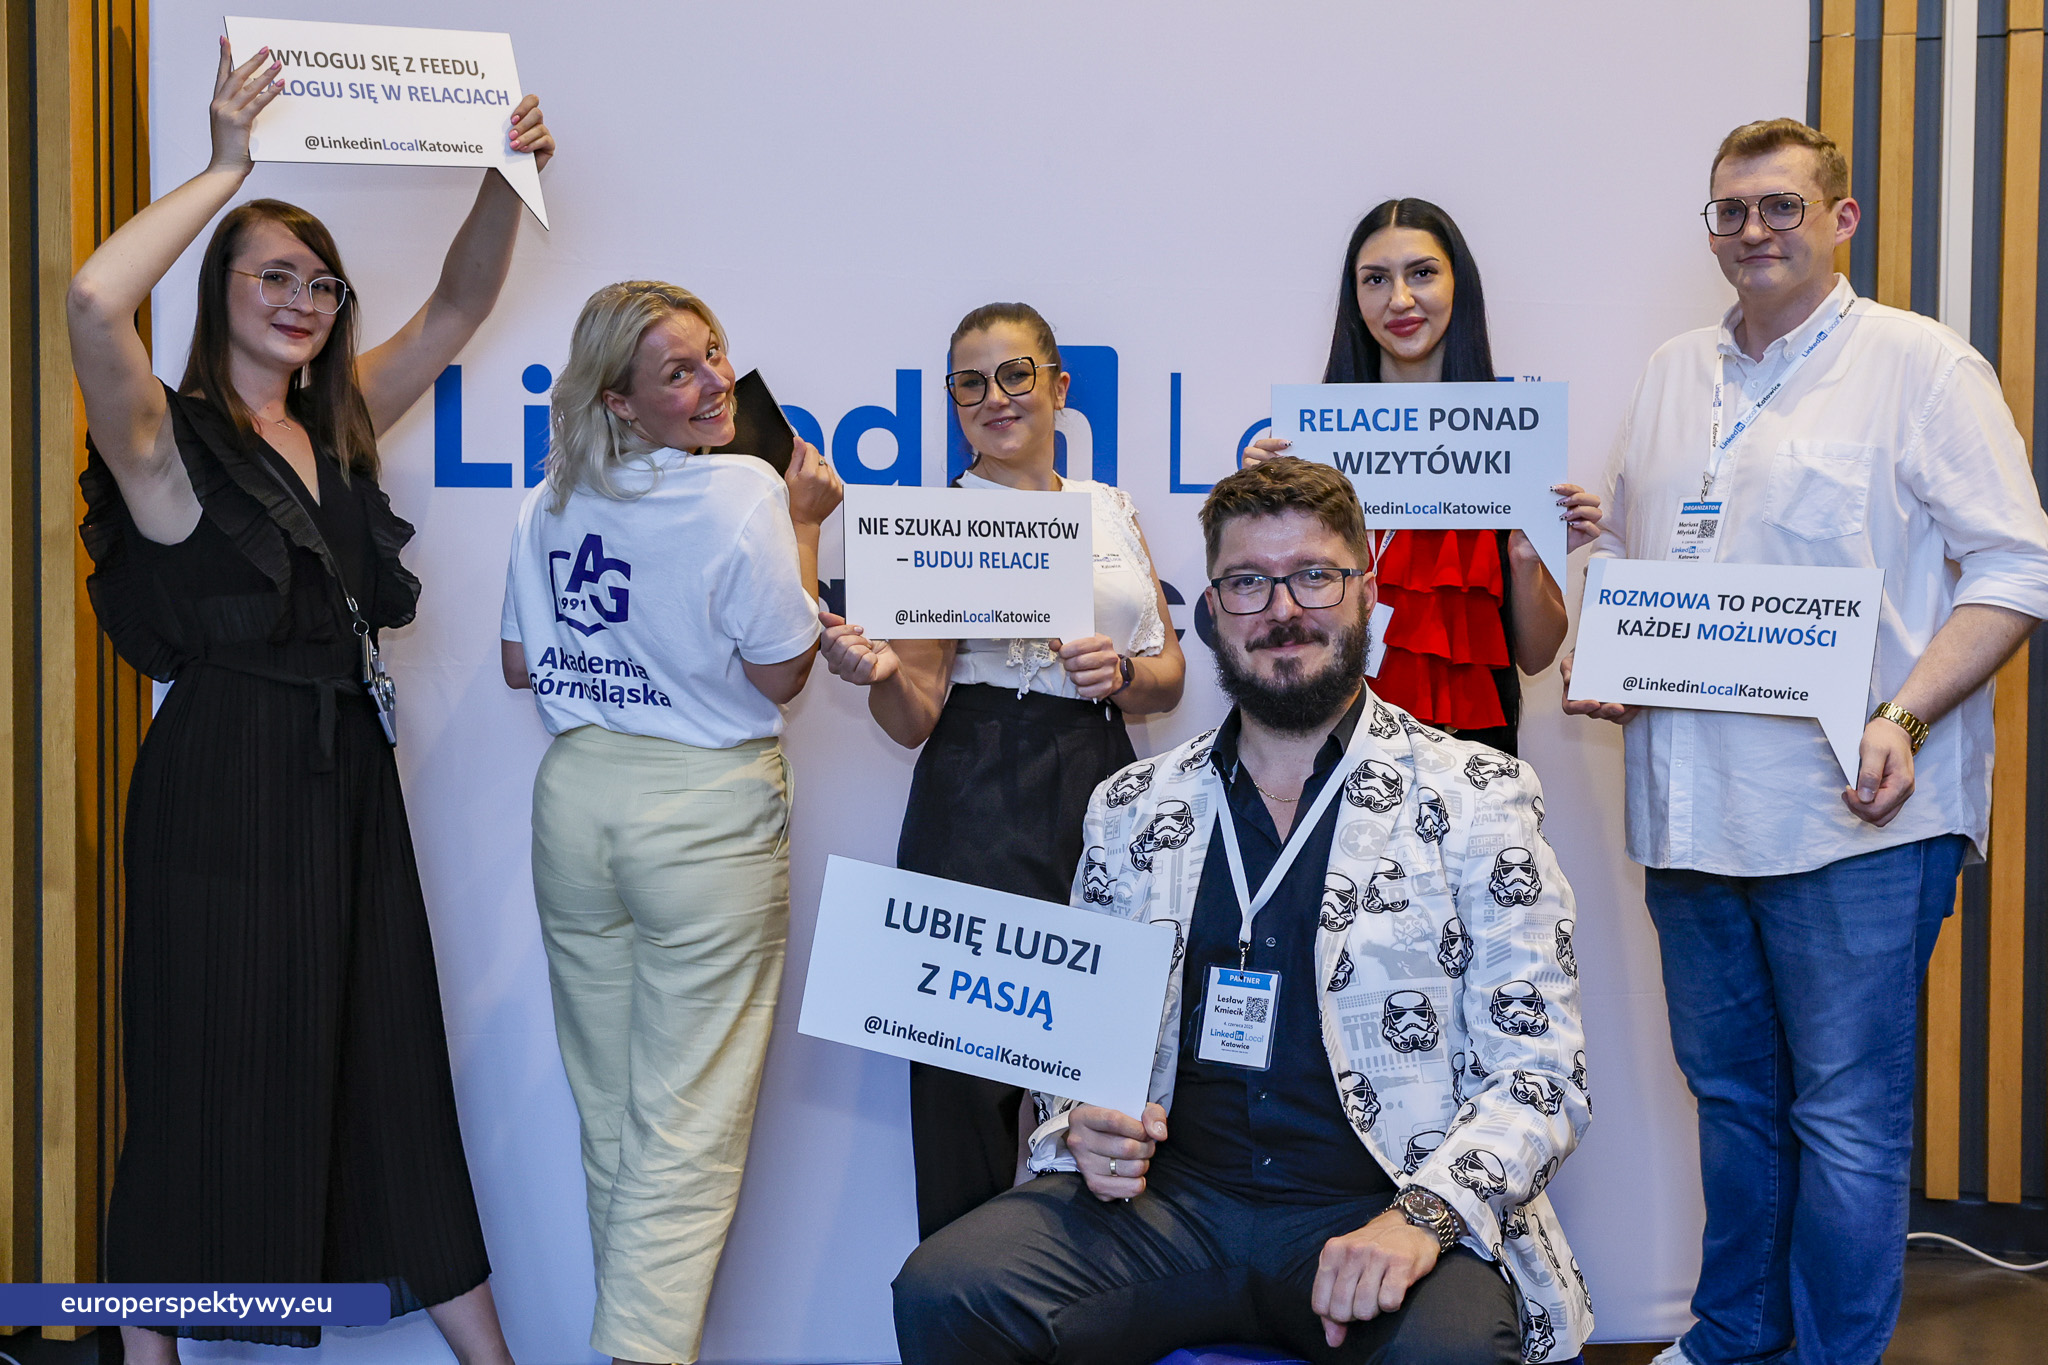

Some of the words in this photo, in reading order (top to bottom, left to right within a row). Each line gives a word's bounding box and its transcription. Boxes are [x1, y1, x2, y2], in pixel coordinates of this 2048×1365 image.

[268, 49, 366, 70] WYLOGUJ
[371, 54, 401, 76] SIĘ
[403, 56, 416, 73] Z
[420, 57, 485, 80] FEEDU,
[256, 79, 343, 98] LOGUJ
[348, 82, 379, 104] SIĘ
[381, 84, 401, 101] W
[407, 85, 510, 106] RELACJACH
[304, 135, 484, 154] @LinkedinLocalKatowice
[1756, 382, 1782, 408] Katowice
[1299, 407, 1419, 432] RELACJE
[1429, 406, 1540, 432] PONAD
[1332, 443, 1512, 475] WIZYTÓWKI
[1363, 500, 1512, 516] kedinLocalKatowice
[857, 516, 889, 536] NIE
[894, 518, 962, 538] SZUKAJ
[967, 517, 1080, 540] KONTAKTÓW
[913, 550, 974, 569] BUDUJ
[979, 551, 1050, 570] RELACJE
[894, 609, 1051, 625] @LinkedinLocalKatowice
[1598, 588, 1711, 611] ROZMOWA
[1717, 594, 1745, 612] TO
[1751, 595, 1862, 620] POCZĄTEK
[1616, 616, 1692, 639] KAŻDEJ
[1696, 621, 1838, 648] MOŻLIWOŚCI
[538, 646, 651, 682] Akademia
[530, 672, 672, 709] Górnośląska
[1622, 675, 1810, 702] @LinkedinLocalKatowice
[884, 897, 987, 957] LUBIĘ
[995, 922, 1103, 976] LUDZI
[916, 962, 941, 996] Z
[948, 969, 1055, 1032] PASJĄ
[1217, 994, 1244, 1005] Lesław
[1214, 1005, 1244, 1017] Kmiecik
[1342, 1011, 1384, 1024] STOR
[863, 1015, 1082, 1082] @LinkedinLocalKatowice
[1220, 1040, 1250, 1050] Katowice
[1245, 1033, 1265, 1043] Local
